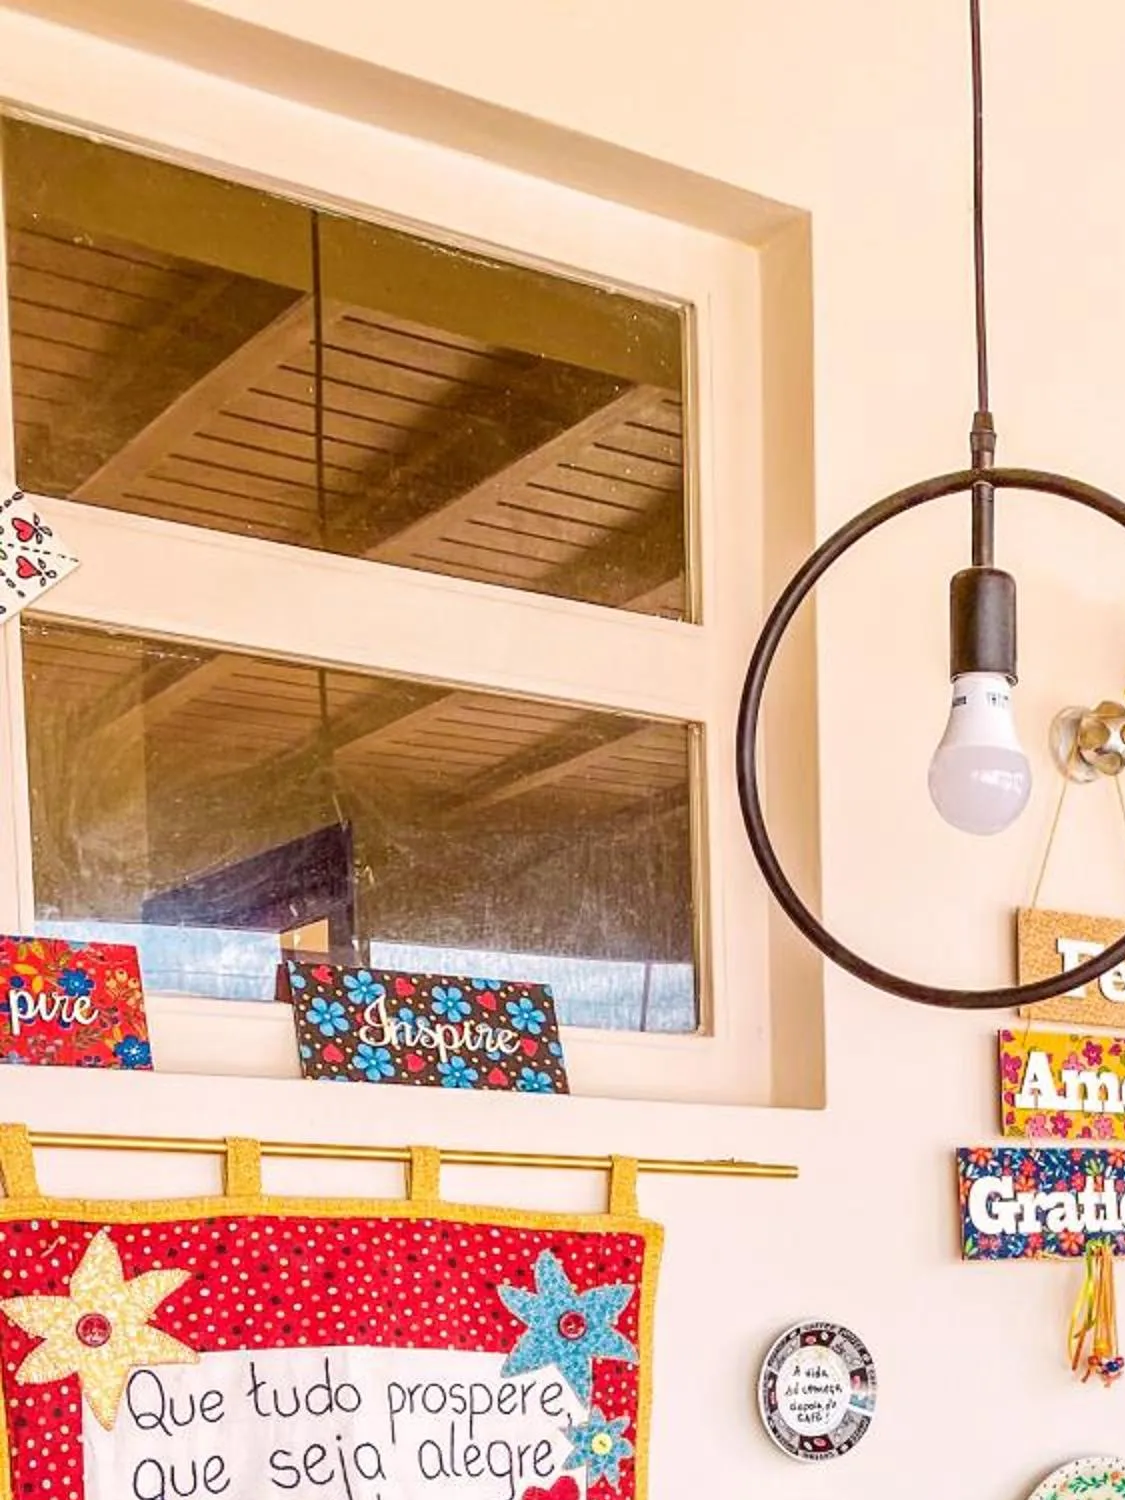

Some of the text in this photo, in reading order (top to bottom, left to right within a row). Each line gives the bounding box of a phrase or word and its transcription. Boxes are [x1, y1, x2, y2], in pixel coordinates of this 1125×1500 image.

[358, 990, 524, 1060] Inspire
[126, 1356, 573, 1444] Que tudo prospere,
[804, 1365, 830, 1378] vida
